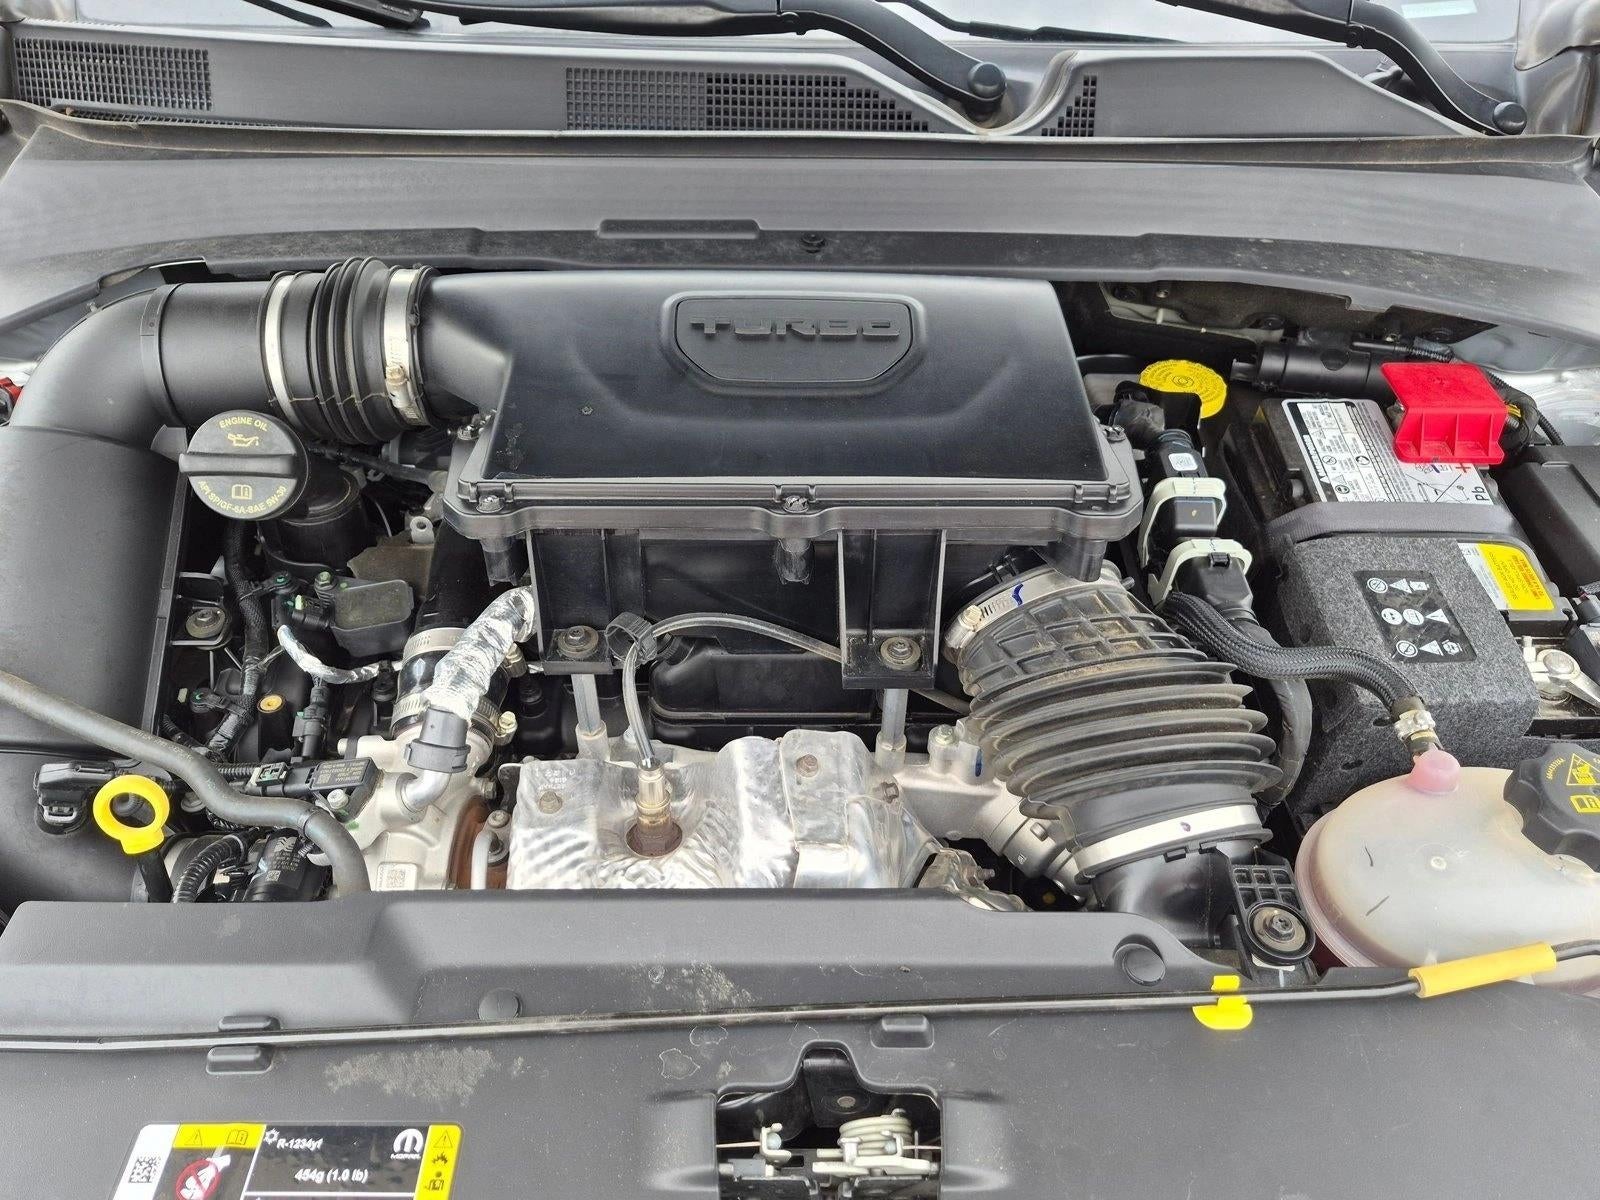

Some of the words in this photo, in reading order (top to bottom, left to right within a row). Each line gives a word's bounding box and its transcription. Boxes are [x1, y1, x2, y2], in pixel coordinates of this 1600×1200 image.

[689, 315, 900, 338] TURBO
[219, 416, 253, 429] ENGINE
[254, 418, 268, 432] OIL
[276, 1137, 324, 1152] R-1234yf
[294, 1168, 325, 1184] 454g
[326, 1168, 350, 1184] (1.0
[351, 1168, 369, 1184] lb)
